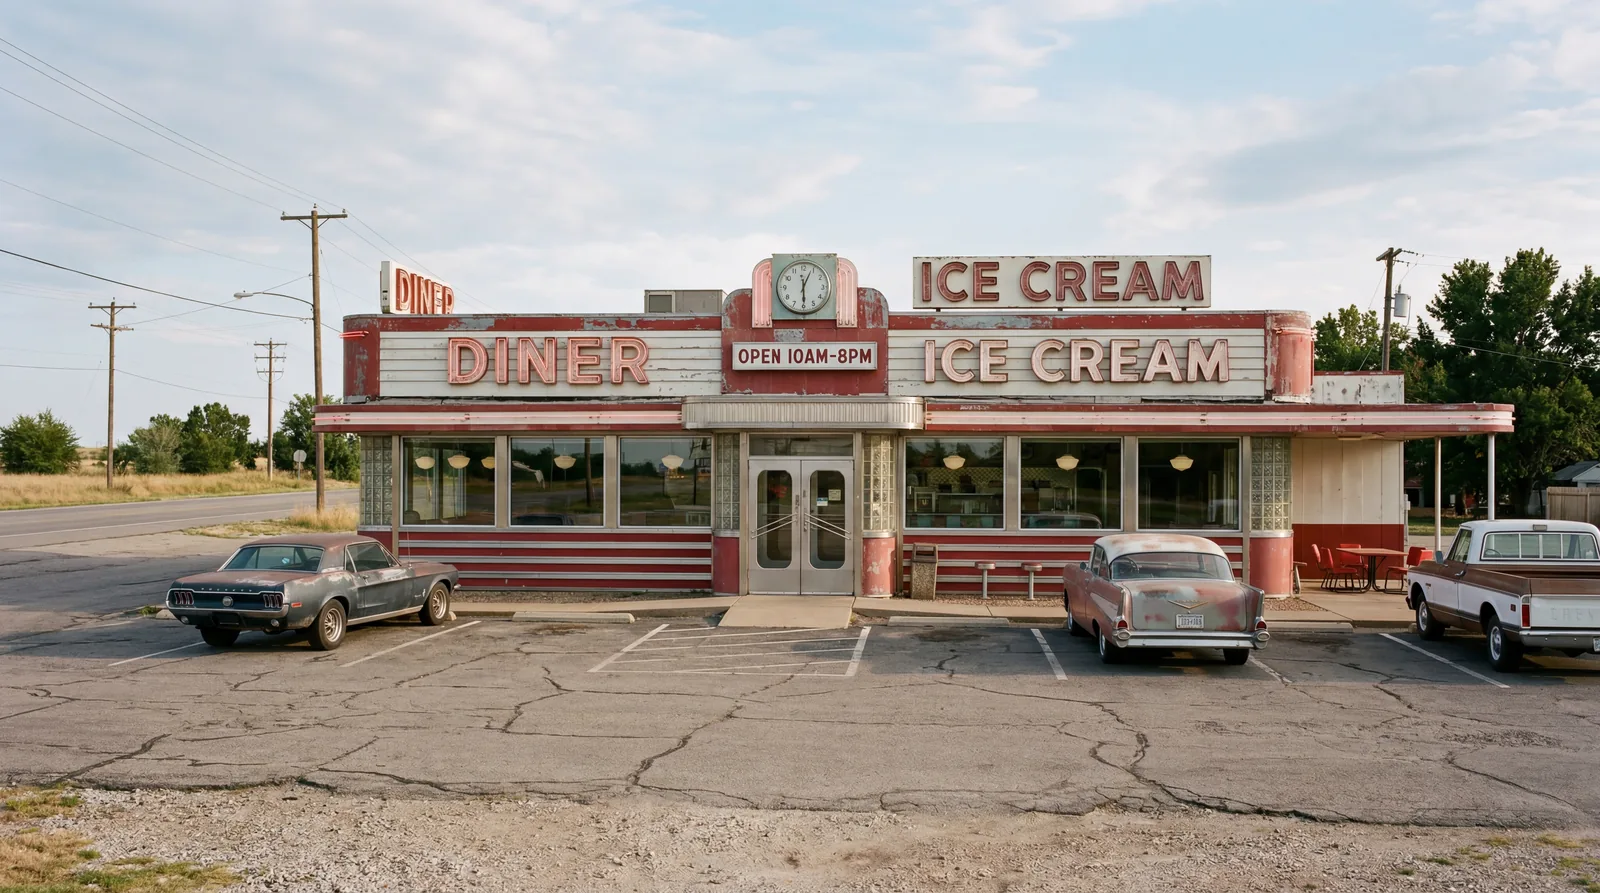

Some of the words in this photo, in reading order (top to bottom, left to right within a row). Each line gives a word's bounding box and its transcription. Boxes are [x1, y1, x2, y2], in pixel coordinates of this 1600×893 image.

[395, 268, 455, 314] DINER
[921, 261, 1000, 302] ICE
[1019, 261, 1204, 302] CREAM
[448, 337, 649, 385] DINER
[738, 348, 781, 364] OPEN
[788, 348, 872, 364] 10AM-8PM
[924, 339, 1009, 383] ICE
[1031, 339, 1230, 383] CREAM
